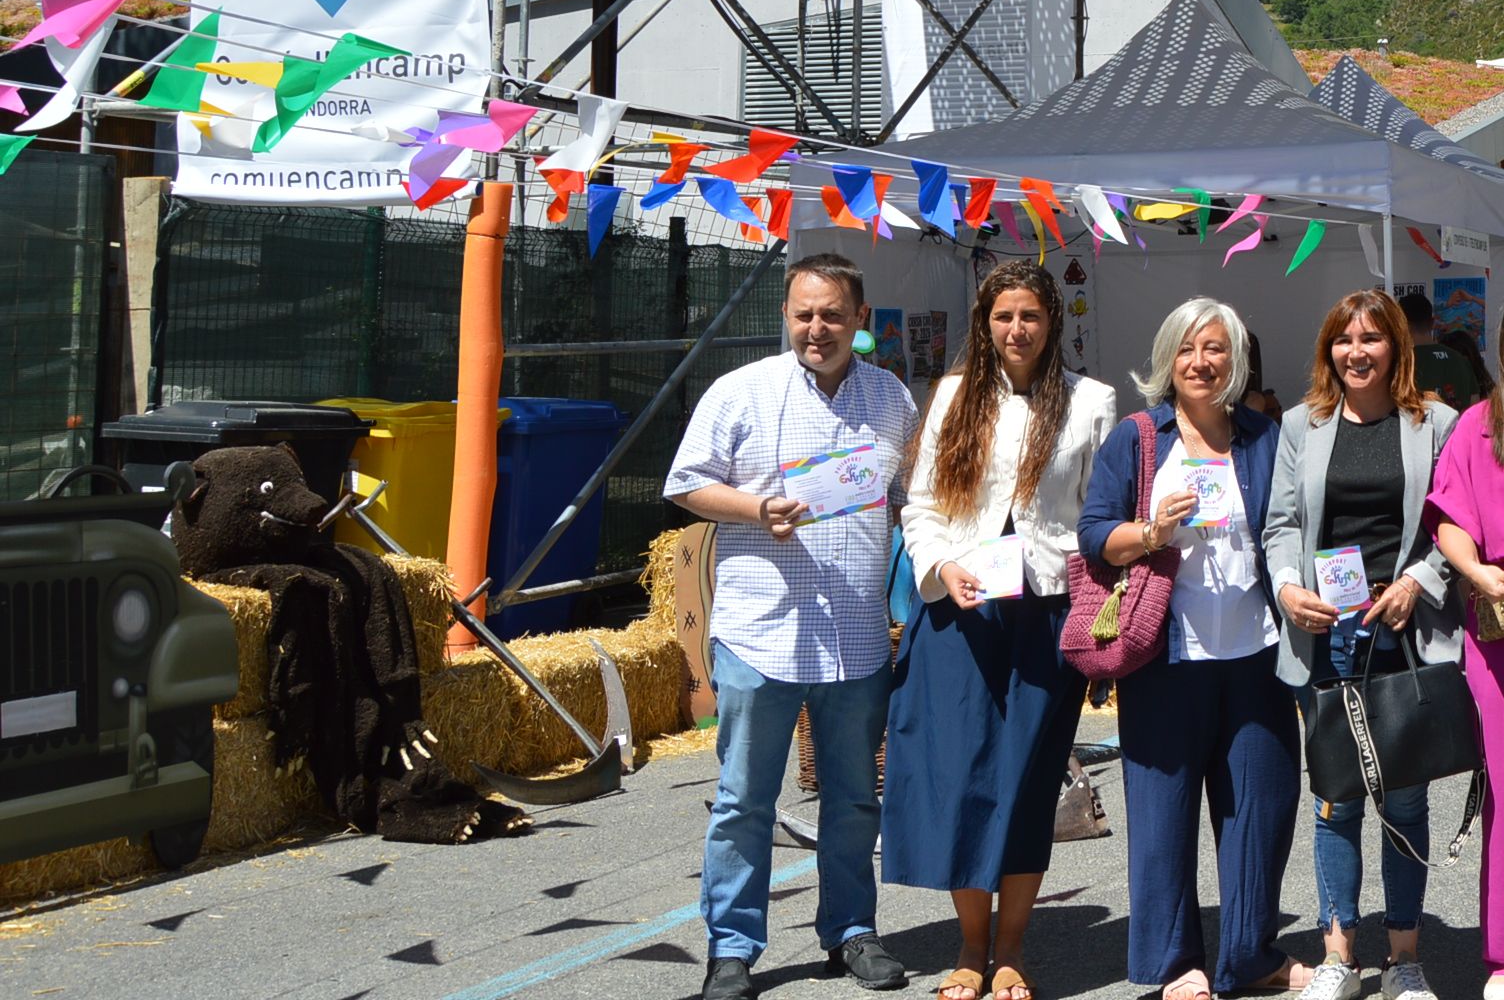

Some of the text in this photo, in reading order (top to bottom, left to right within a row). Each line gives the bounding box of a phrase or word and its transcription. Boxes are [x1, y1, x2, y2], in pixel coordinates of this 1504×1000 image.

[304, 99, 372, 117] NDORRA
[1366, 762, 1380, 792] KARL
[1465, 793, 1477, 822] KARL
